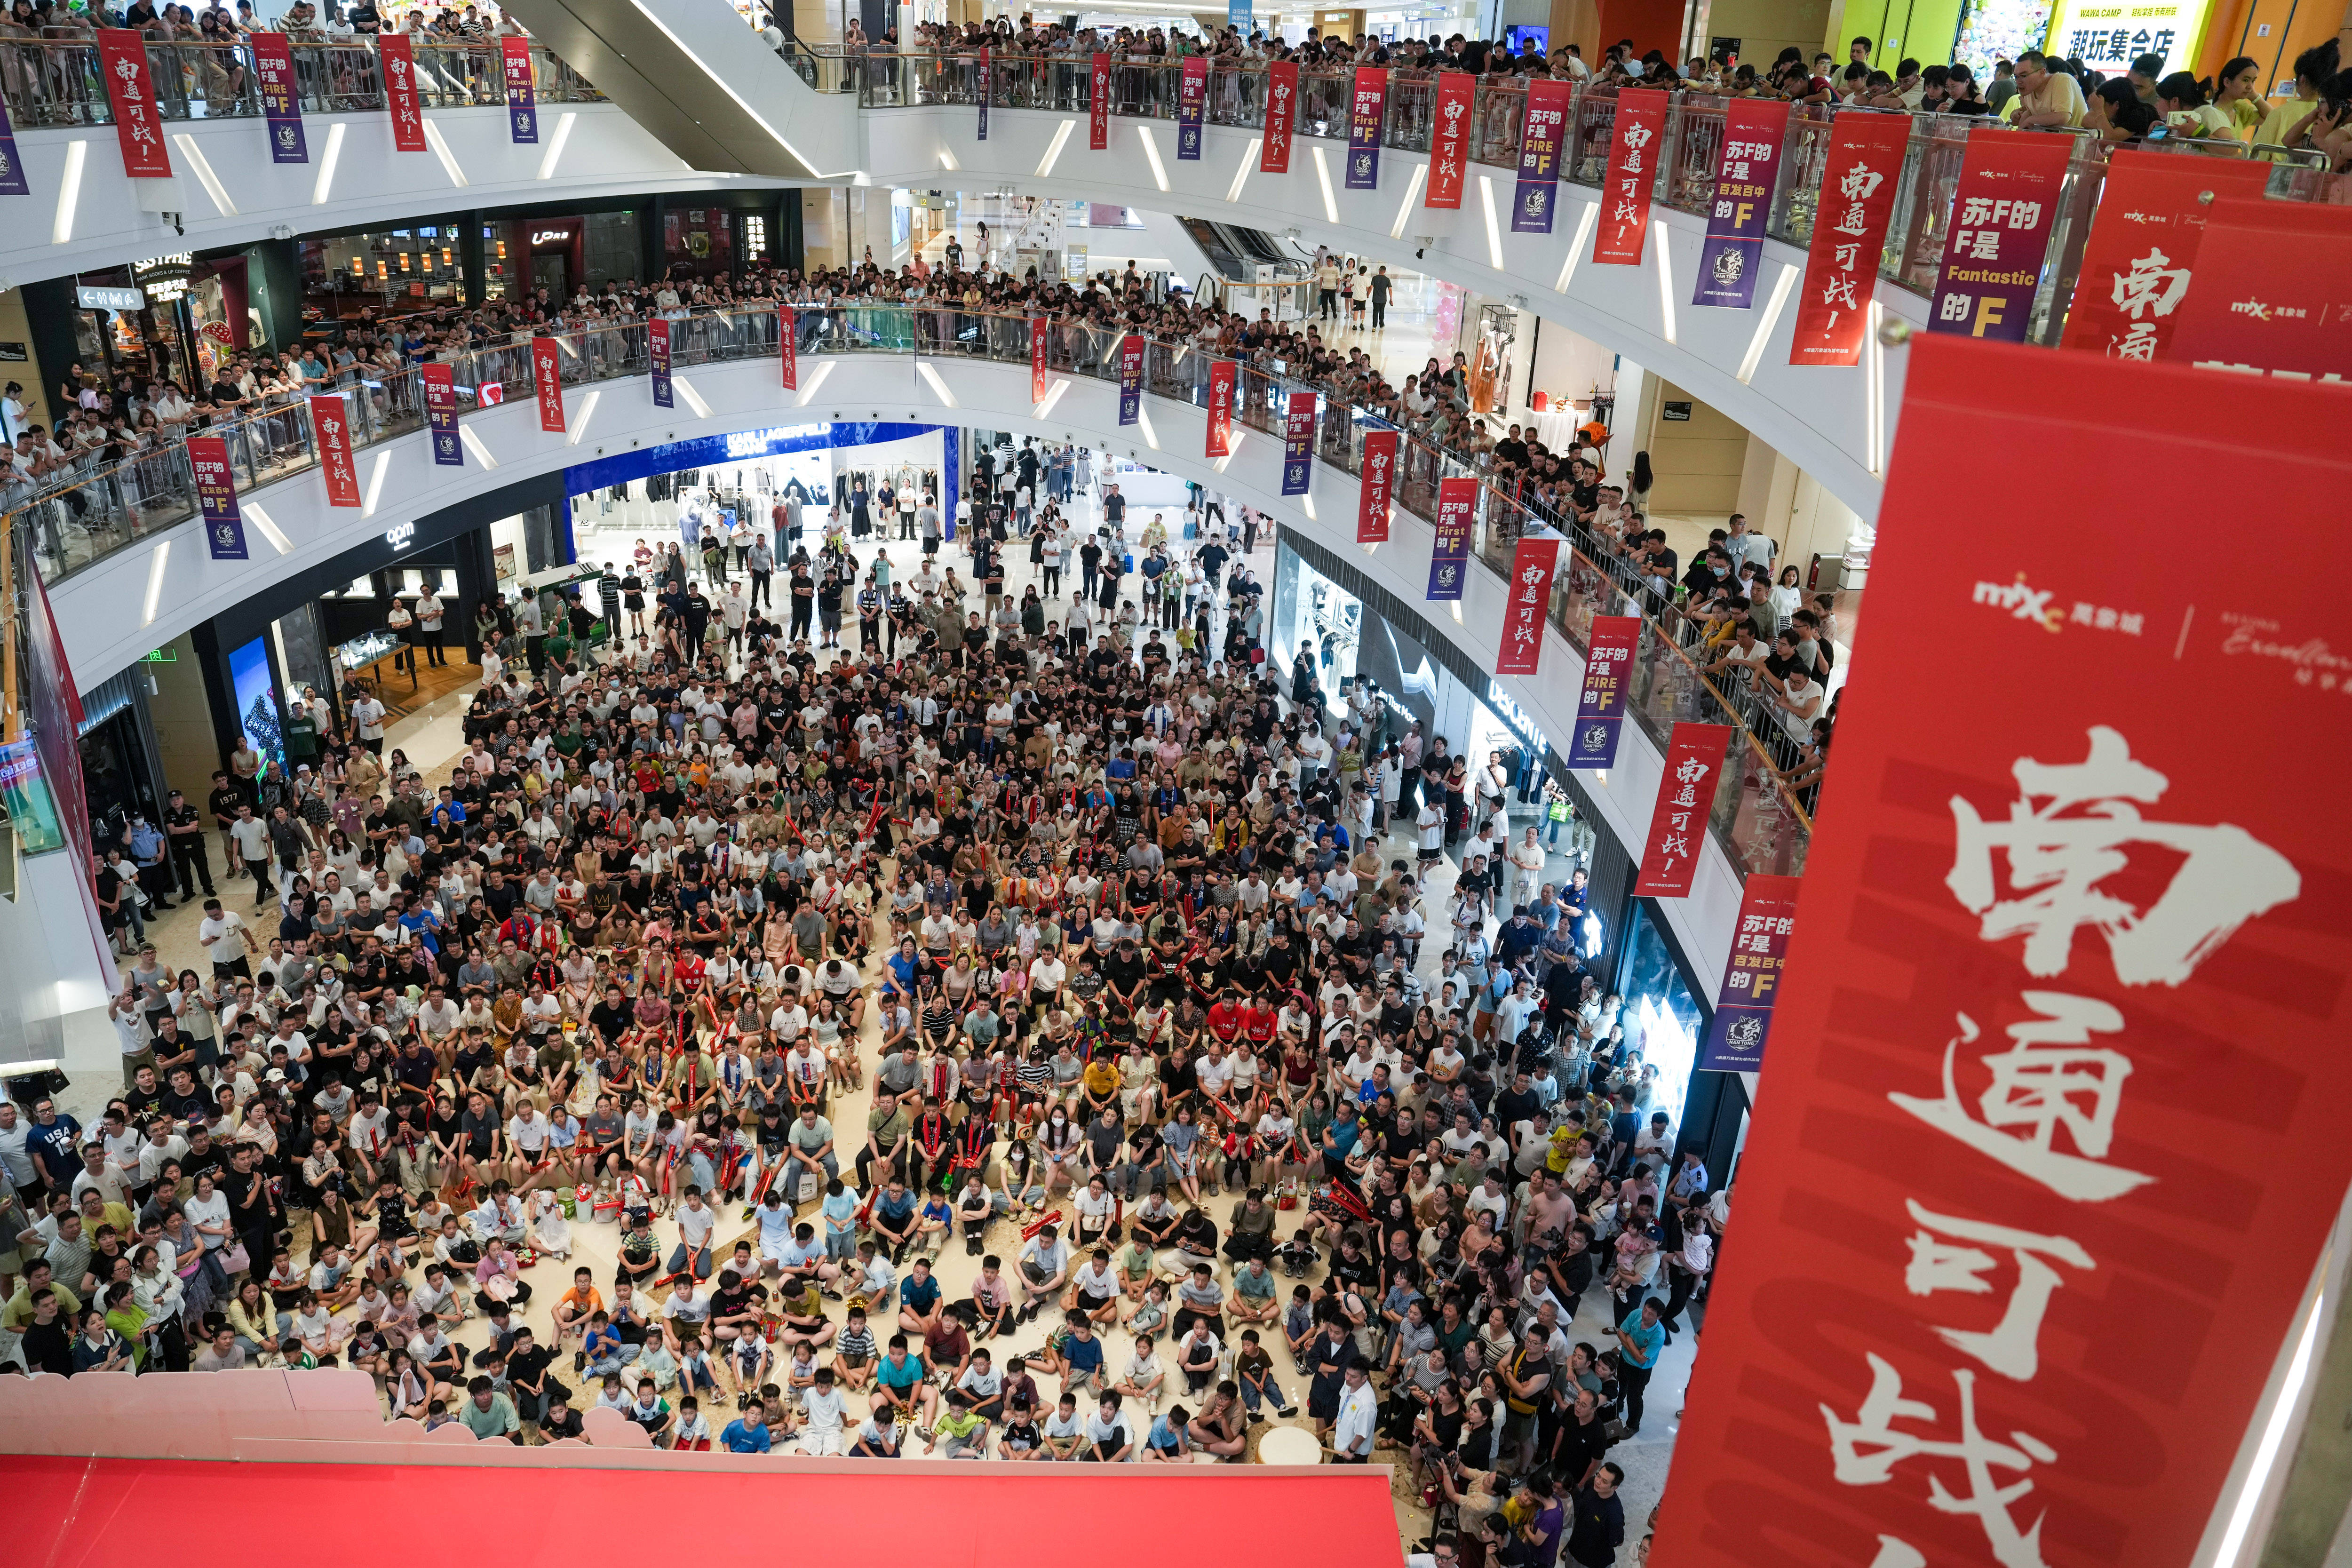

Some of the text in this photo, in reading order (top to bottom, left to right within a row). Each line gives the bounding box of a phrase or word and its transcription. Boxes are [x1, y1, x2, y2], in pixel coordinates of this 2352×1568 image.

[2080, 8, 2121, 17] WAWA CAMP
[2131, 7, 2177, 17] 轻松拿捏 币有所获
[2067, 28, 2176, 62] 潮玩集合店
[260, 59, 286, 70] 苏F的
[506, 58, 526, 67] 苏F的
[261, 72, 278, 82] F是
[507, 69, 519, 77] F是
[805, 69, 813, 80] L3
[1185, 77, 1202, 87] 苏F的
[263, 85, 287, 94] FIRE
[510, 89, 526, 102] 的 F
[1184, 87, 1194, 96] F是
[1357, 91, 1381, 103] 苏F的
[266, 96, 289, 113] 的 F
[1356, 103, 1369, 114] F是
[1183, 107, 1197, 120] 的 F
[1530, 110, 1561, 124] 苏F的
[1355, 115, 1377, 125] First
[1354, 127, 1374, 143] 的 F
[1528, 125, 1546, 138] F是
[1526, 140, 1553, 152] FIRE
[1726, 141, 1772, 161] 苏F的
[1524, 154, 1550, 174] 的 F
[1722, 161, 1749, 180] F是
[1719, 183, 1765, 197] 百发百中
[1715, 200, 1754, 228] 的 F
[1962, 198, 2041, 230] 苏F的
[1954, 230, 2000, 260] F是
[1948, 266, 2034, 286] Fantastic
[1940, 293, 2007, 337] 的 F
[2275, 306, 2307, 319] 萬象城
[652, 336, 666, 345] 苏F的
[660, 362, 666, 373] F
[428, 384, 449, 393] 苏F的
[1130, 379, 1136, 390] F
[429, 394, 442, 402] F是
[432, 413, 450, 426] 的 F
[1290, 413, 1311, 422] 苏F的
[1289, 423, 1301, 432] F是
[727, 422, 831, 446] KARL LAGERFELD
[727, 443, 767, 458] JEANS
[1288, 443, 1305, 455] 的 F
[195, 462, 224, 472] 苏F的
[198, 474, 216, 484] F是
[203, 497, 227, 512] 的 F
[1442, 502, 1469, 513] 苏F的
[1440, 514, 1455, 525] F是
[1438, 526, 1465, 535] First
[1437, 537, 1460, 553] 的 F
[559, 579, 582, 588] Heineken
[1592, 647, 1628, 661] 苏F的
[1589, 662, 1610, 675] F是
[1586, 677, 1617, 688] FIRE
[1388, 694, 1402, 714] That
[1584, 691, 1614, 710] 的 F
[219, 793, 238, 805] 1977
[1738, 934, 1770, 953] F是
[1729, 971, 1775, 998] 的 F
[45, 1126, 71, 1144] USA
[1819, 726, 2300, 1568] 南通可战
